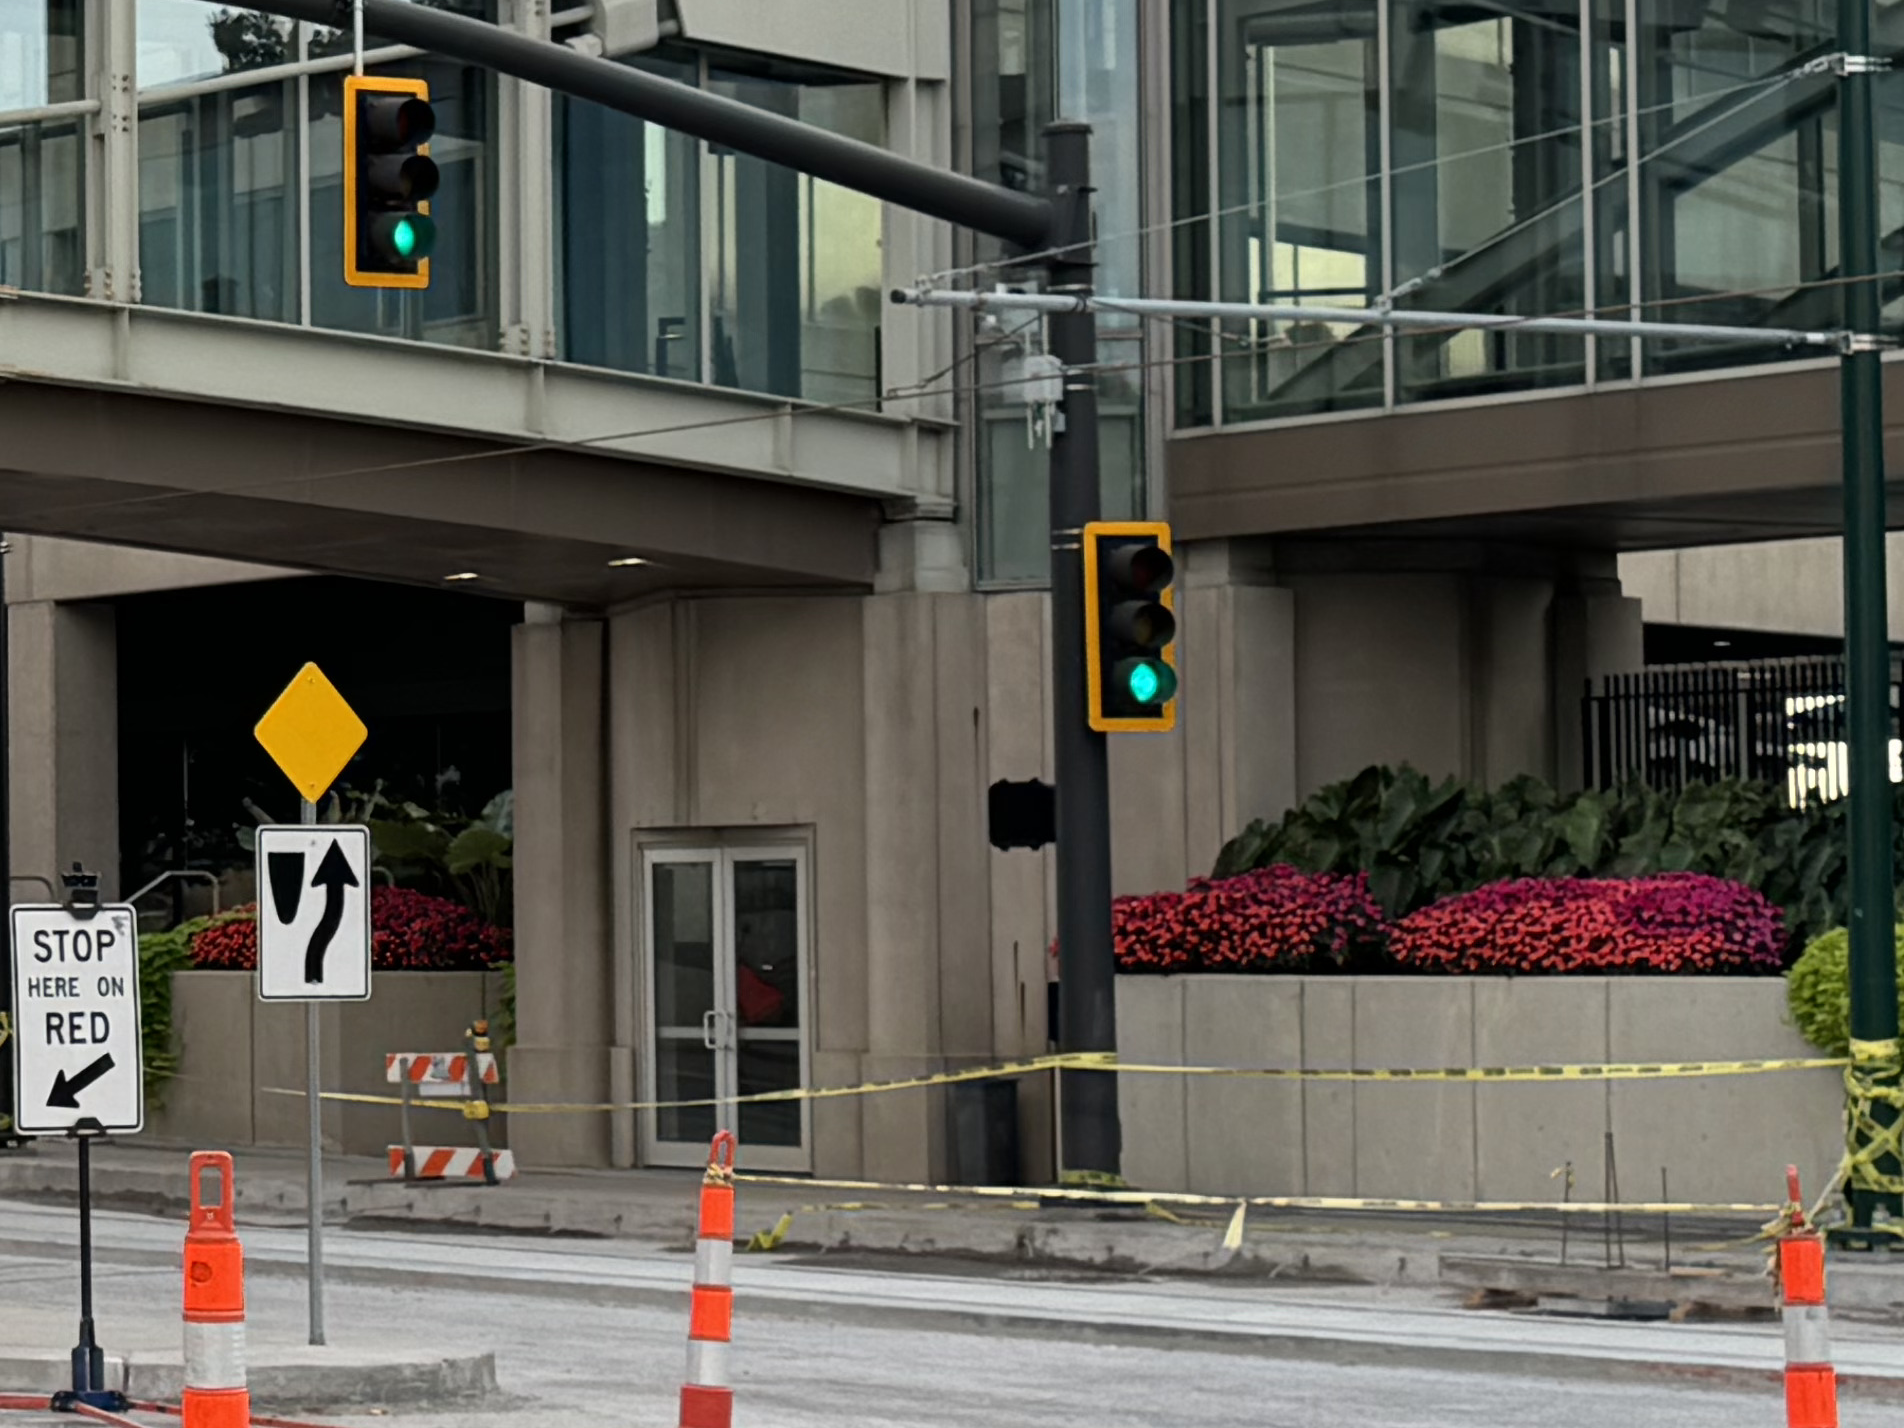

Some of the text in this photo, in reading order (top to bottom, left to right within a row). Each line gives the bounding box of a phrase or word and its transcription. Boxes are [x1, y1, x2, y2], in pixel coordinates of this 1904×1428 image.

[33, 929, 116, 963] STOP
[27, 976, 125, 998] HERE ON
[45, 1011, 111, 1045] RED
